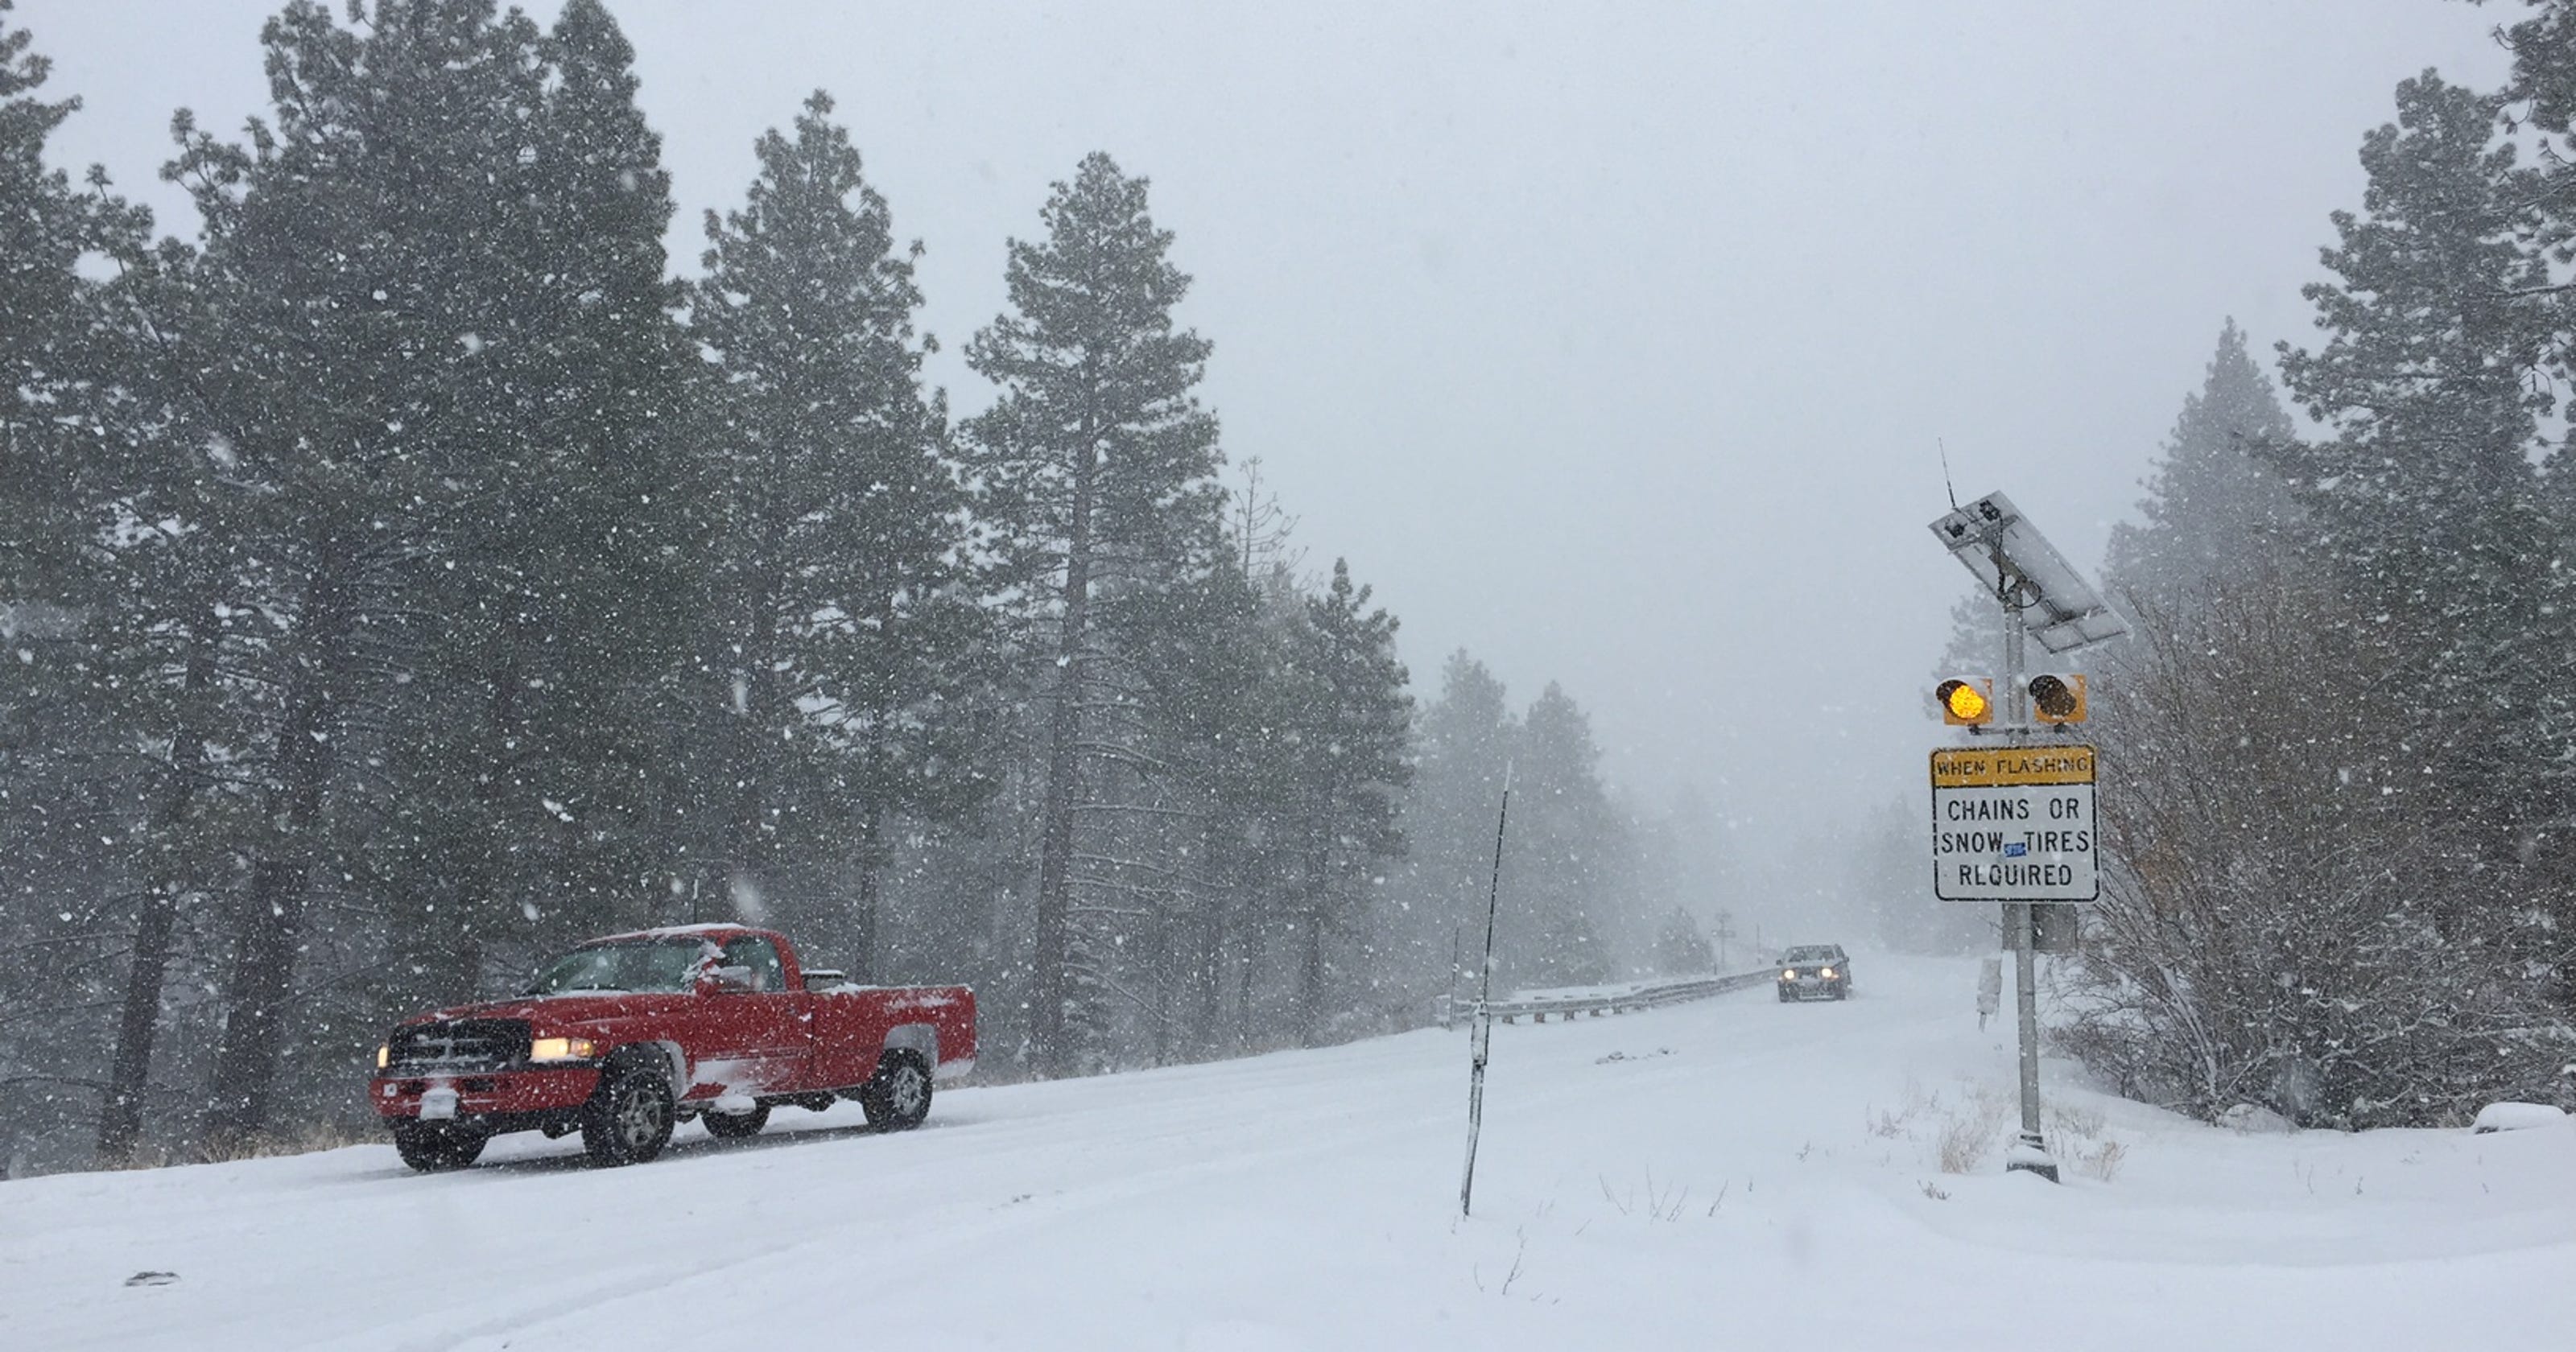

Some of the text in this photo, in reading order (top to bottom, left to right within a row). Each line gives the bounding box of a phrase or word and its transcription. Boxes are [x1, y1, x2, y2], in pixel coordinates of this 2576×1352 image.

[1936, 756, 2088, 776] WHEN FLASHING
[1947, 798, 2079, 821] CHAINS OR
[1941, 832, 2004, 853] SNOW
[2024, 831, 2090, 852] TIRES
